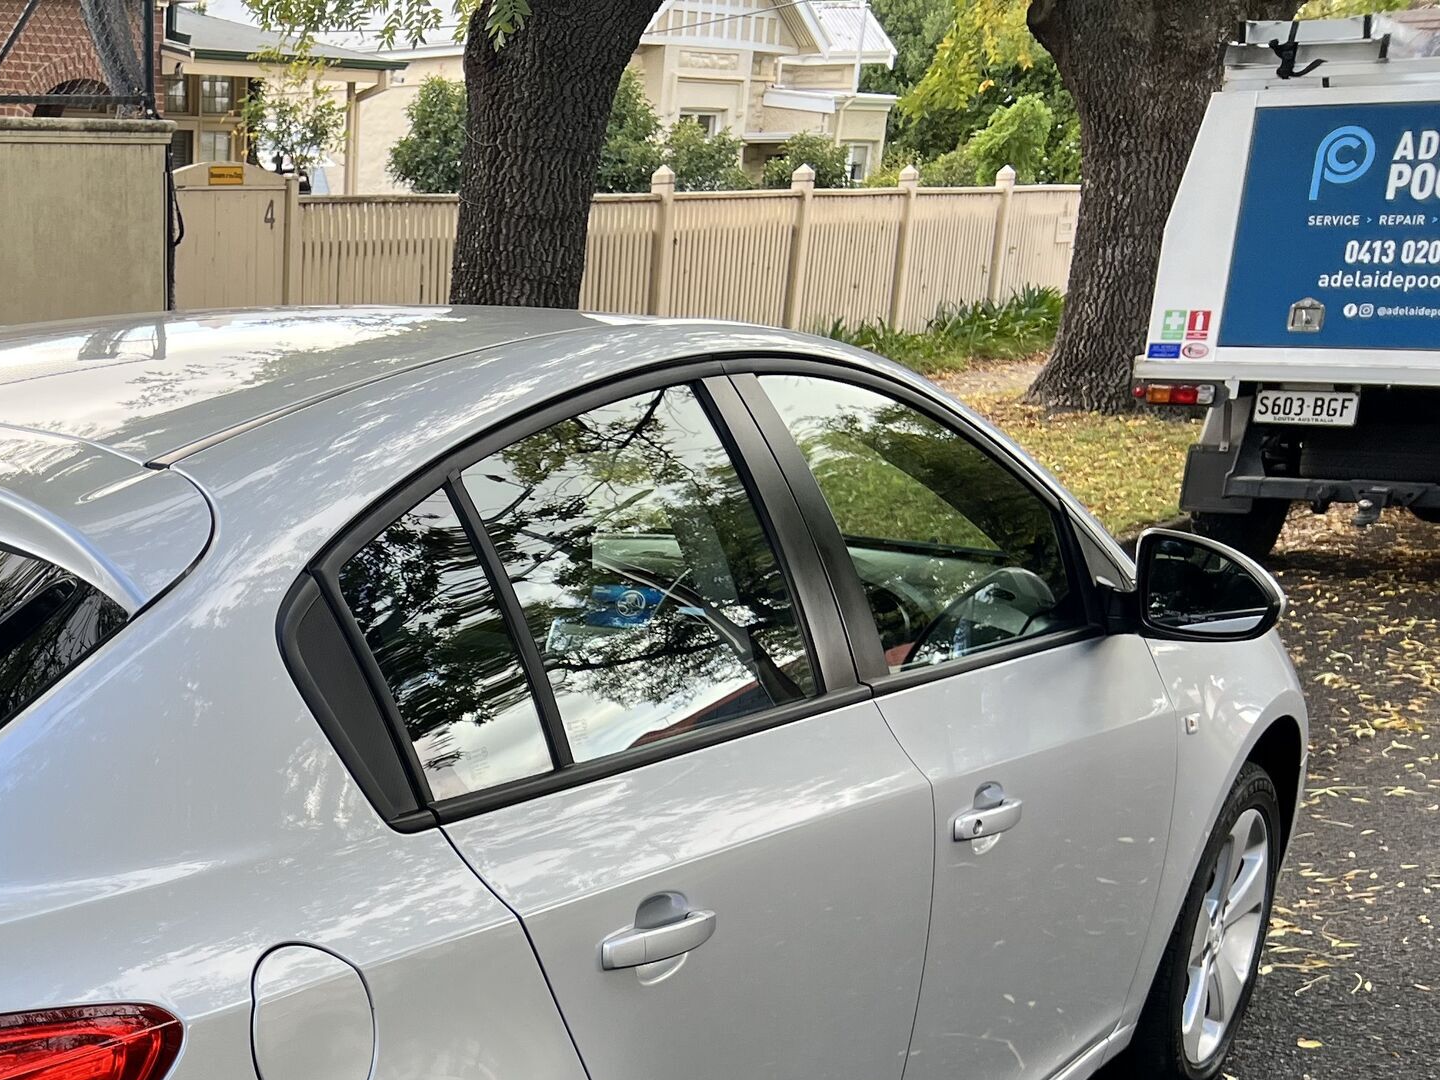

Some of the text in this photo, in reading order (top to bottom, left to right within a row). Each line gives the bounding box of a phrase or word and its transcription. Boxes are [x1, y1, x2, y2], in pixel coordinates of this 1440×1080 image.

[1392, 130, 1440, 160] AD
[1385, 162, 1440, 200] PO
[264, 199, 275, 230] 4
[1308, 214, 1425, 226] SERVICE REPAIR
[1344, 240, 1440, 264] 0413 020
[1318, 270, 1440, 292] adelaidepoo
